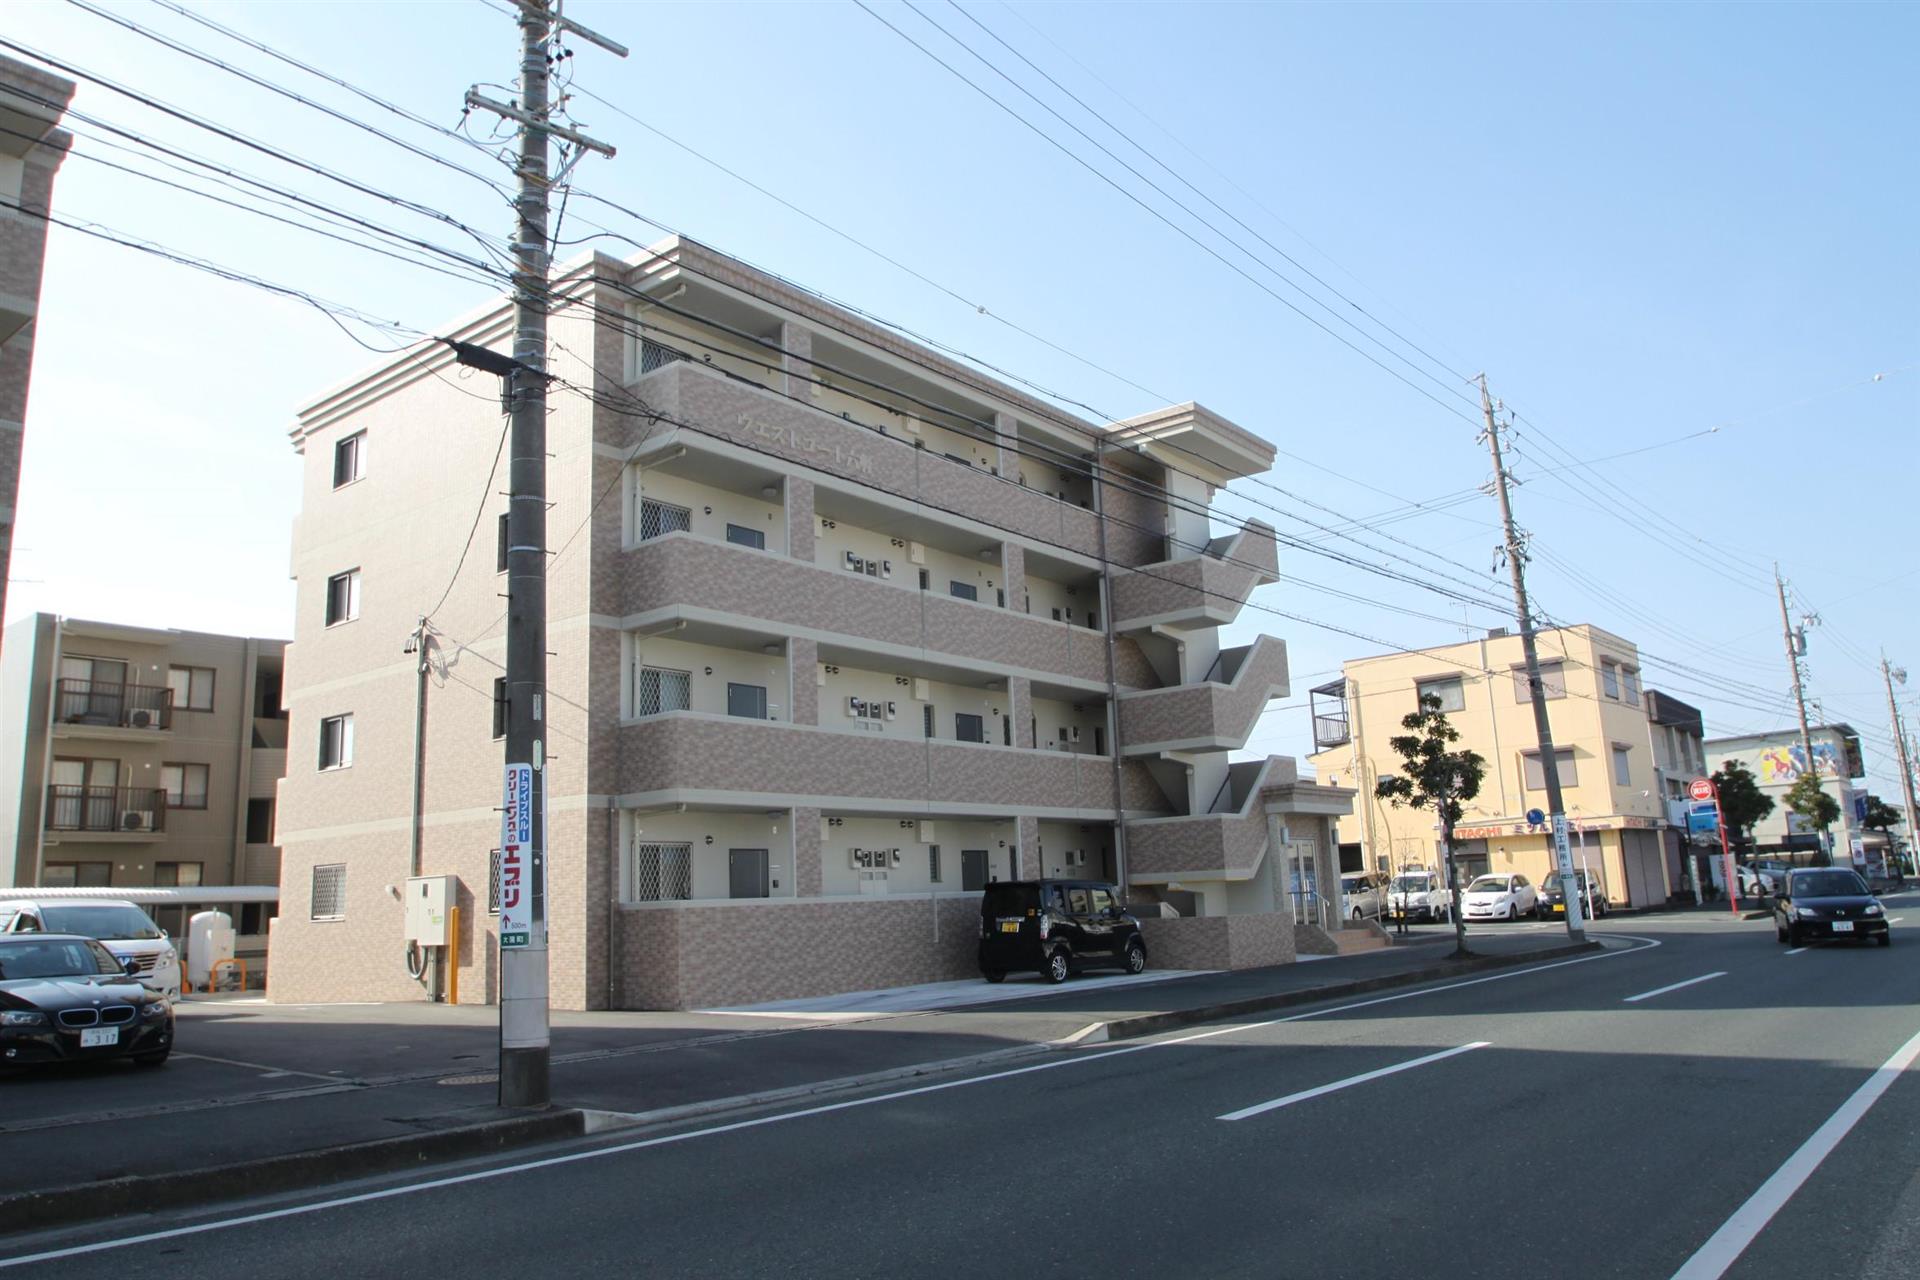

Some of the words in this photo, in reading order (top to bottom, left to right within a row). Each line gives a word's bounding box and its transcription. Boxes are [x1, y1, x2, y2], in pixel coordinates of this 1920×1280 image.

[520, 770, 528, 841] ドライブスルー
[1455, 826, 1502, 839] ITACHI
